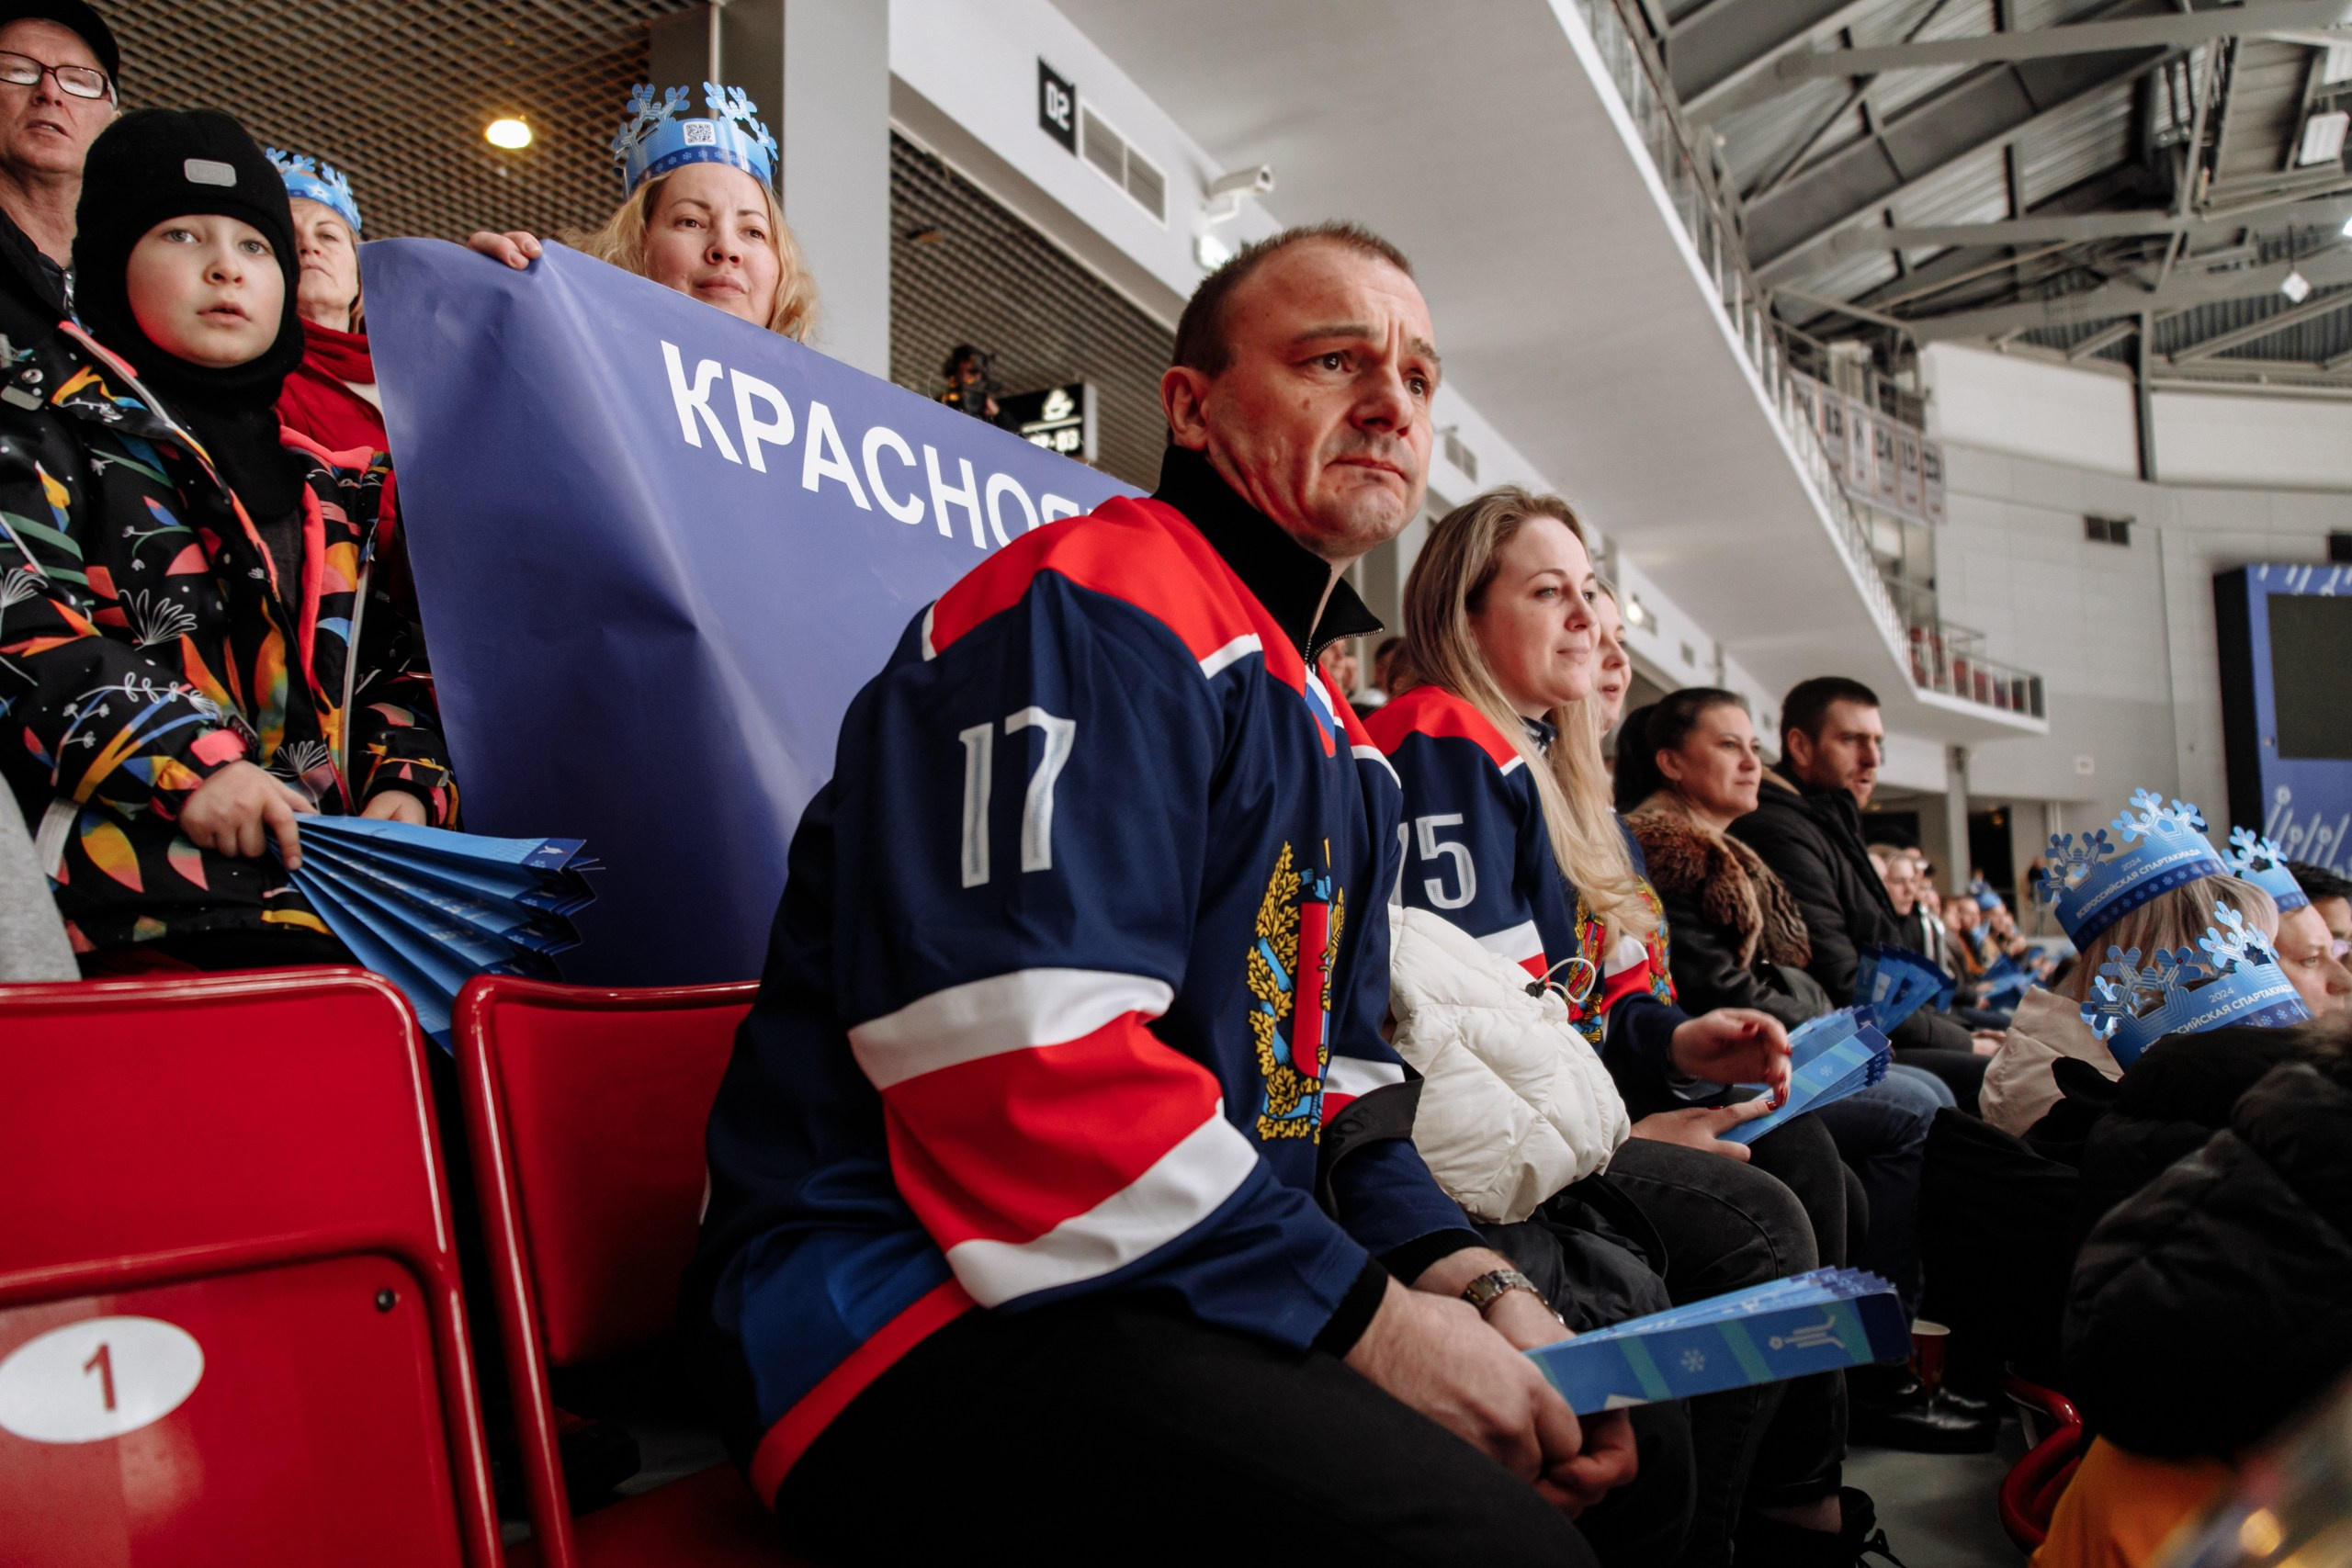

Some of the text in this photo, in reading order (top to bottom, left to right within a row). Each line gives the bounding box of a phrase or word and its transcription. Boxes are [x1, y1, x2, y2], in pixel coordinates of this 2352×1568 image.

[1046, 80, 1070, 131] 02
[660, 339, 1094, 551] КРАСНО
[957, 705, 1077, 889] 17
[2120, 856, 2143, 873] 2024
[2138, 847, 2203, 876] СПАРТАКИАДА
[2208, 986, 2235, 1004] 2024
[83, 1343, 118, 1413] 1
